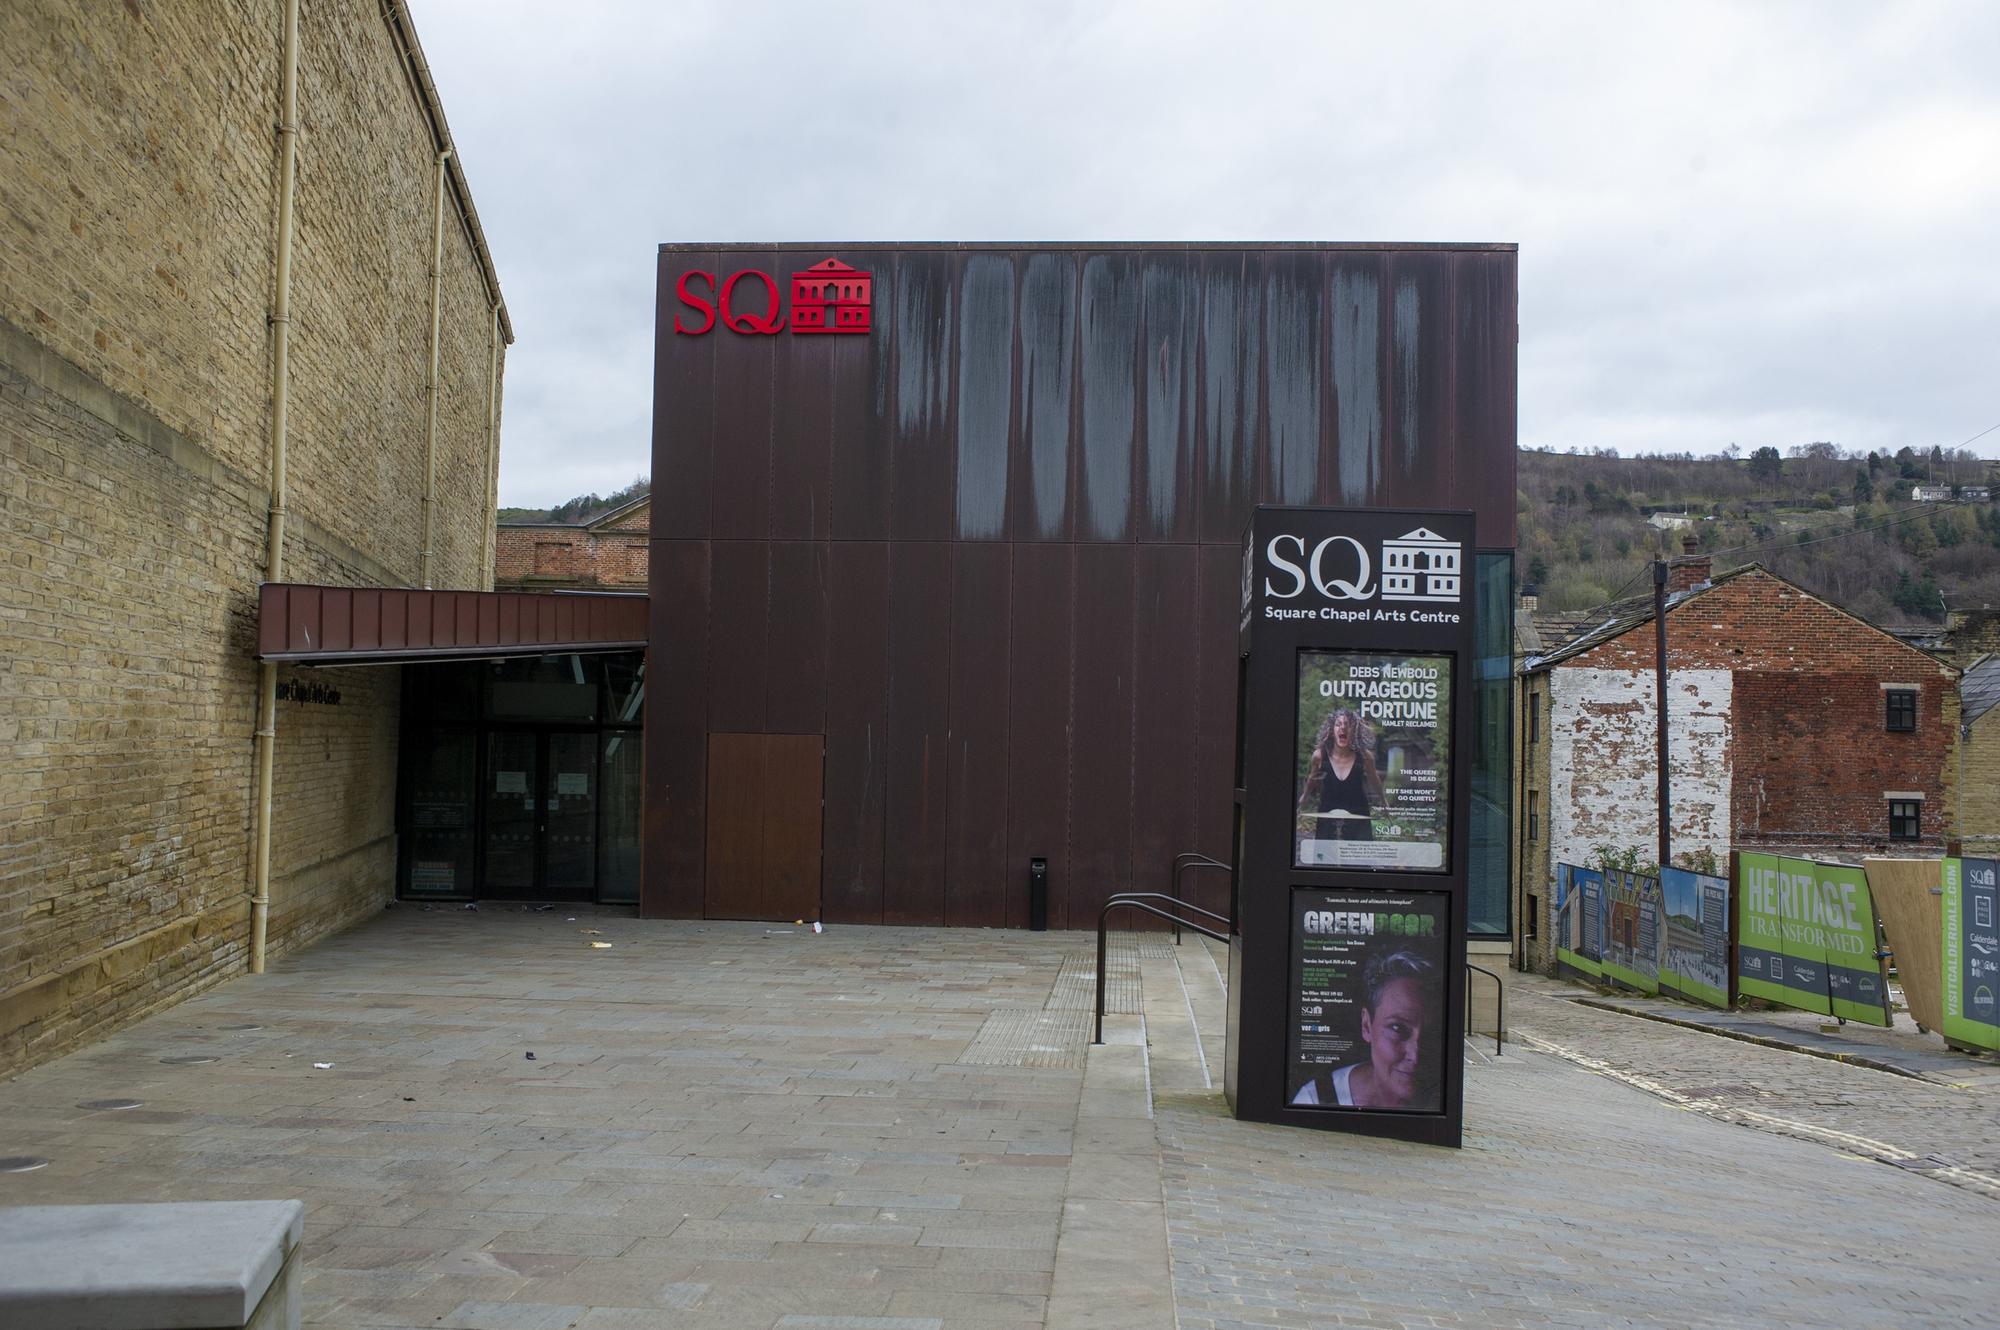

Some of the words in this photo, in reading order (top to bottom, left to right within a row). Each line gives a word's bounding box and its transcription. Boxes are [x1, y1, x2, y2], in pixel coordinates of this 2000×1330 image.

[674, 269, 787, 336] SQ
[1265, 534, 1377, 601] SQ
[1265, 606, 1317, 620] Square
[1320, 607, 1370, 622] Chapel
[1374, 609, 1406, 622] Arts
[1410, 610, 1460, 623] Centre
[1349, 666, 1380, 678] DEBS
[1383, 667, 1438, 679] NEWBOLD
[1319, 680, 1438, 699] OUTRAGEOUS
[1361, 701, 1437, 720] FORTUNE
[1375, 825, 1390, 835] SQ
[1969, 869, 1984, 885] SQ
[1748, 867, 1864, 933] HERITAGE
[1748, 915, 1865, 955] TRANSFORMED
[1947, 864, 1959, 1017] VISITCALDERDALE.COM
[1969, 932, 1998, 945] Calderdale
